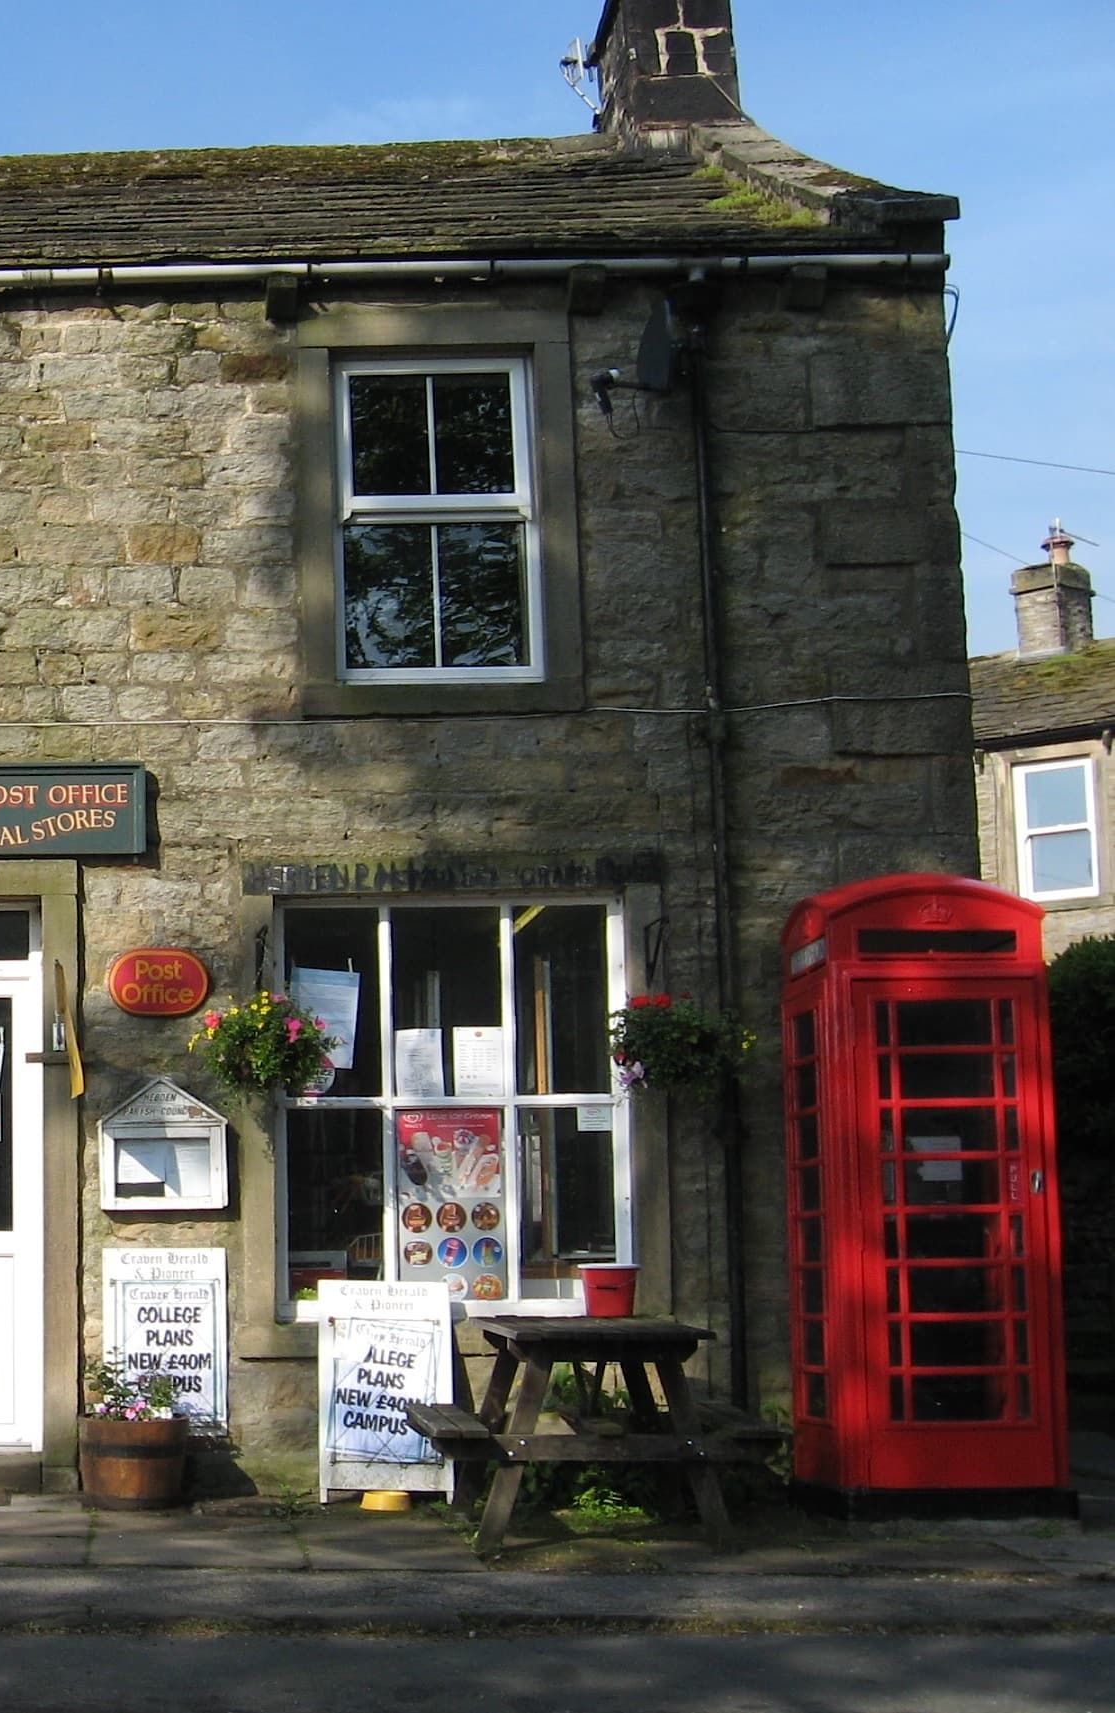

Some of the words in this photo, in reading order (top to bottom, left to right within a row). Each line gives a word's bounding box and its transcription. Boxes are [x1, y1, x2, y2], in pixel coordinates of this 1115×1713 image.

[48, 783, 128, 804] OFFICE
[30, 808, 117, 842] STORES
[135, 959, 183, 981] Post
[121, 982, 194, 1005] Office
[144, 1093, 178, 1102] HEBDEN
[121, 1253, 162, 1265] Craven
[167, 1251, 208, 1265] Herald
[150, 1267, 195, 1280] Pioneer
[339, 1285, 382, 1296] Craven
[387, 1284, 429, 1297] Herald
[137, 1306, 202, 1323] COLLEGE
[146, 1329, 193, 1347] PLANS
[128, 1352, 163, 1370] NEW
[166, 1352, 212, 1370] £40M
[369, 1346, 416, 1369] LLEGE
[138, 1374, 202, 1394] PUS
[357, 1367, 405, 1390] PLANS
[336, 1388, 372, 1408] NEW
[343, 1410, 408, 1436] CAMPUS
